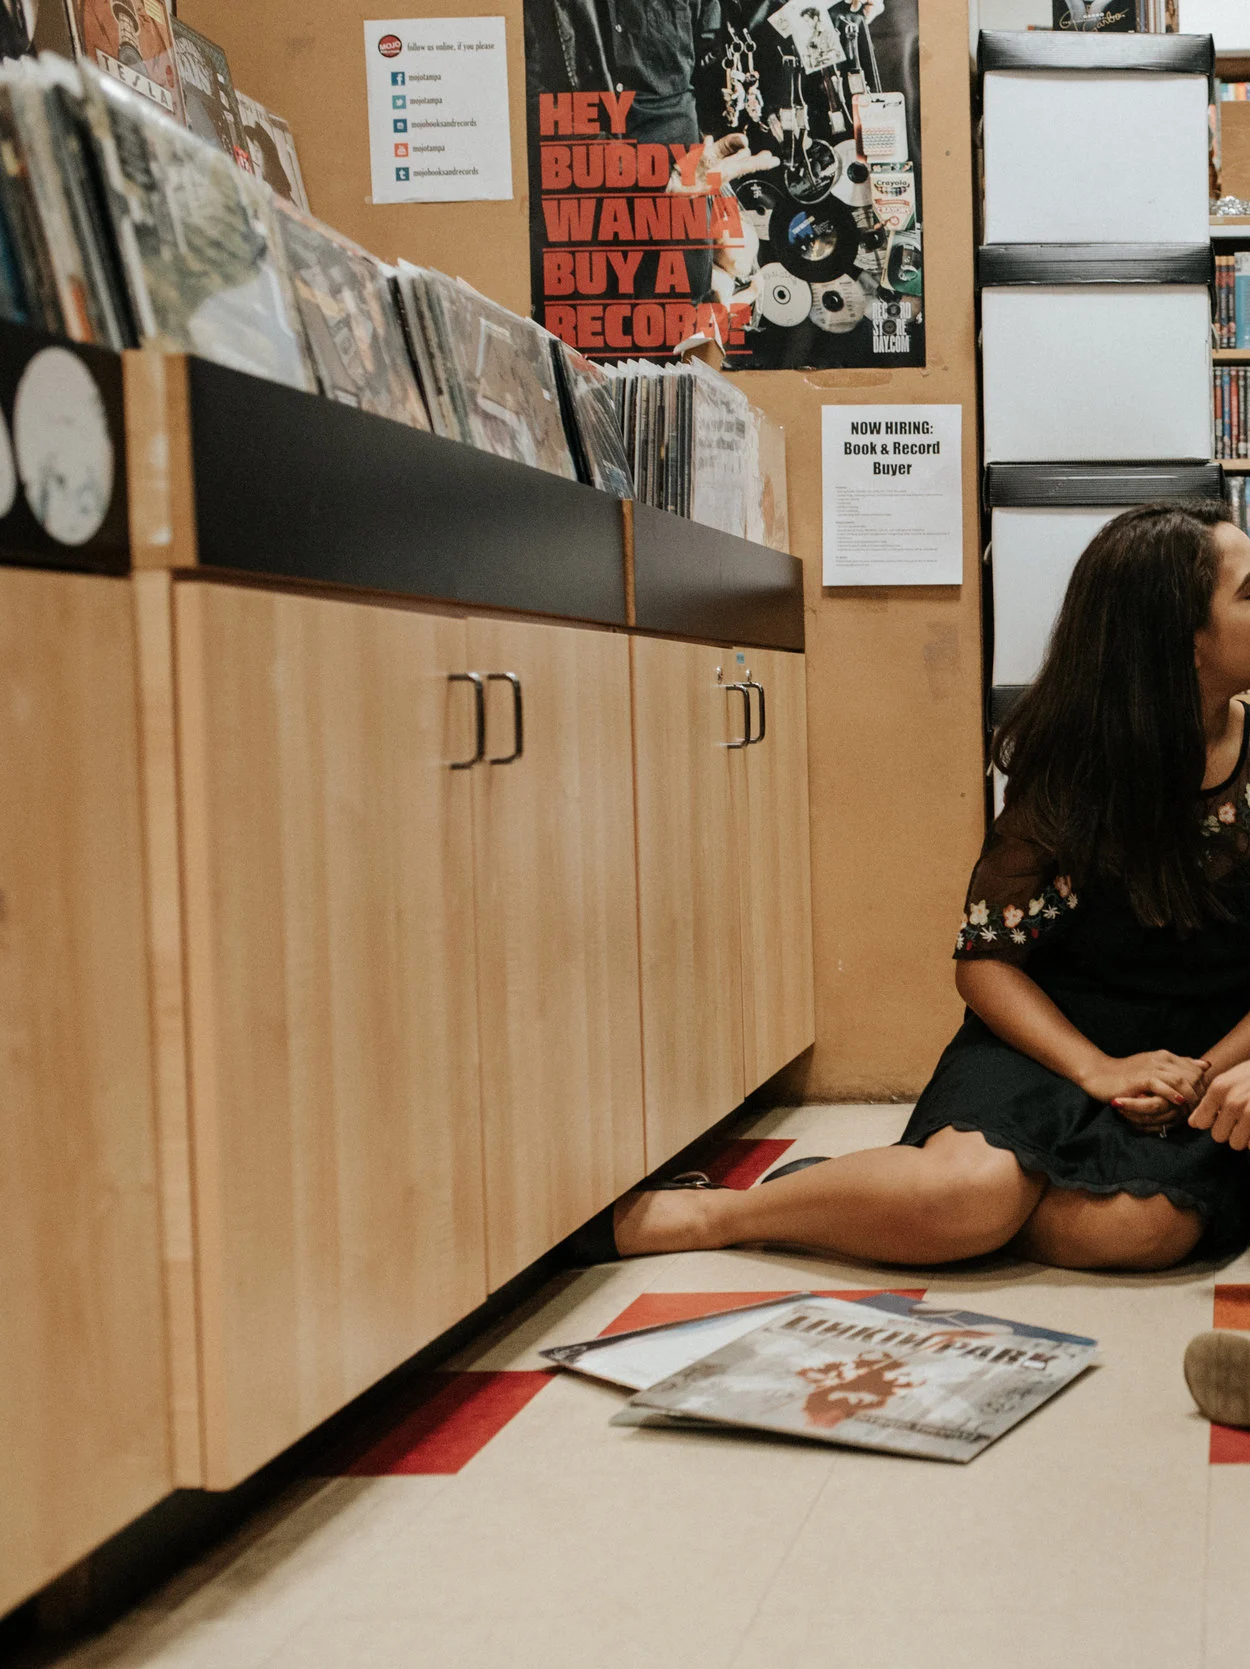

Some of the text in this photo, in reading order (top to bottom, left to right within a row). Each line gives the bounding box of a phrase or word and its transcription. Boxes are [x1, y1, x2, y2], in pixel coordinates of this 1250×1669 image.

[379, 40, 401, 50] MOJO
[407, 41, 425, 51] follow
[436, 42, 456, 51] online,
[457, 41, 463, 50] if
[463, 43, 474, 52] you
[476, 41, 495, 51] please
[409, 73, 442, 82] mojotampa
[410, 96, 443, 105] mojotampa
[538, 90, 636, 136] HEY
[411, 118, 477, 130] mojobooksandrecords
[412, 143, 446, 153] mojotampa
[413, 167, 479, 178] mojobooksandrecords
[540, 143, 723, 192] BUDDY,
[876, 180, 908, 188] Crayola
[541, 196, 745, 242] WANNA
[543, 250, 691, 296] BUY A
[543, 302, 752, 349] RECORD?
[872, 335, 910, 353] DAY.COM
[851, 420, 933, 435] NOW HIRING:
[844, 441, 940, 455] Book & Record
[873, 462, 912, 476] Buyer
[780, 1315, 1060, 1370] LINKIN PARK
